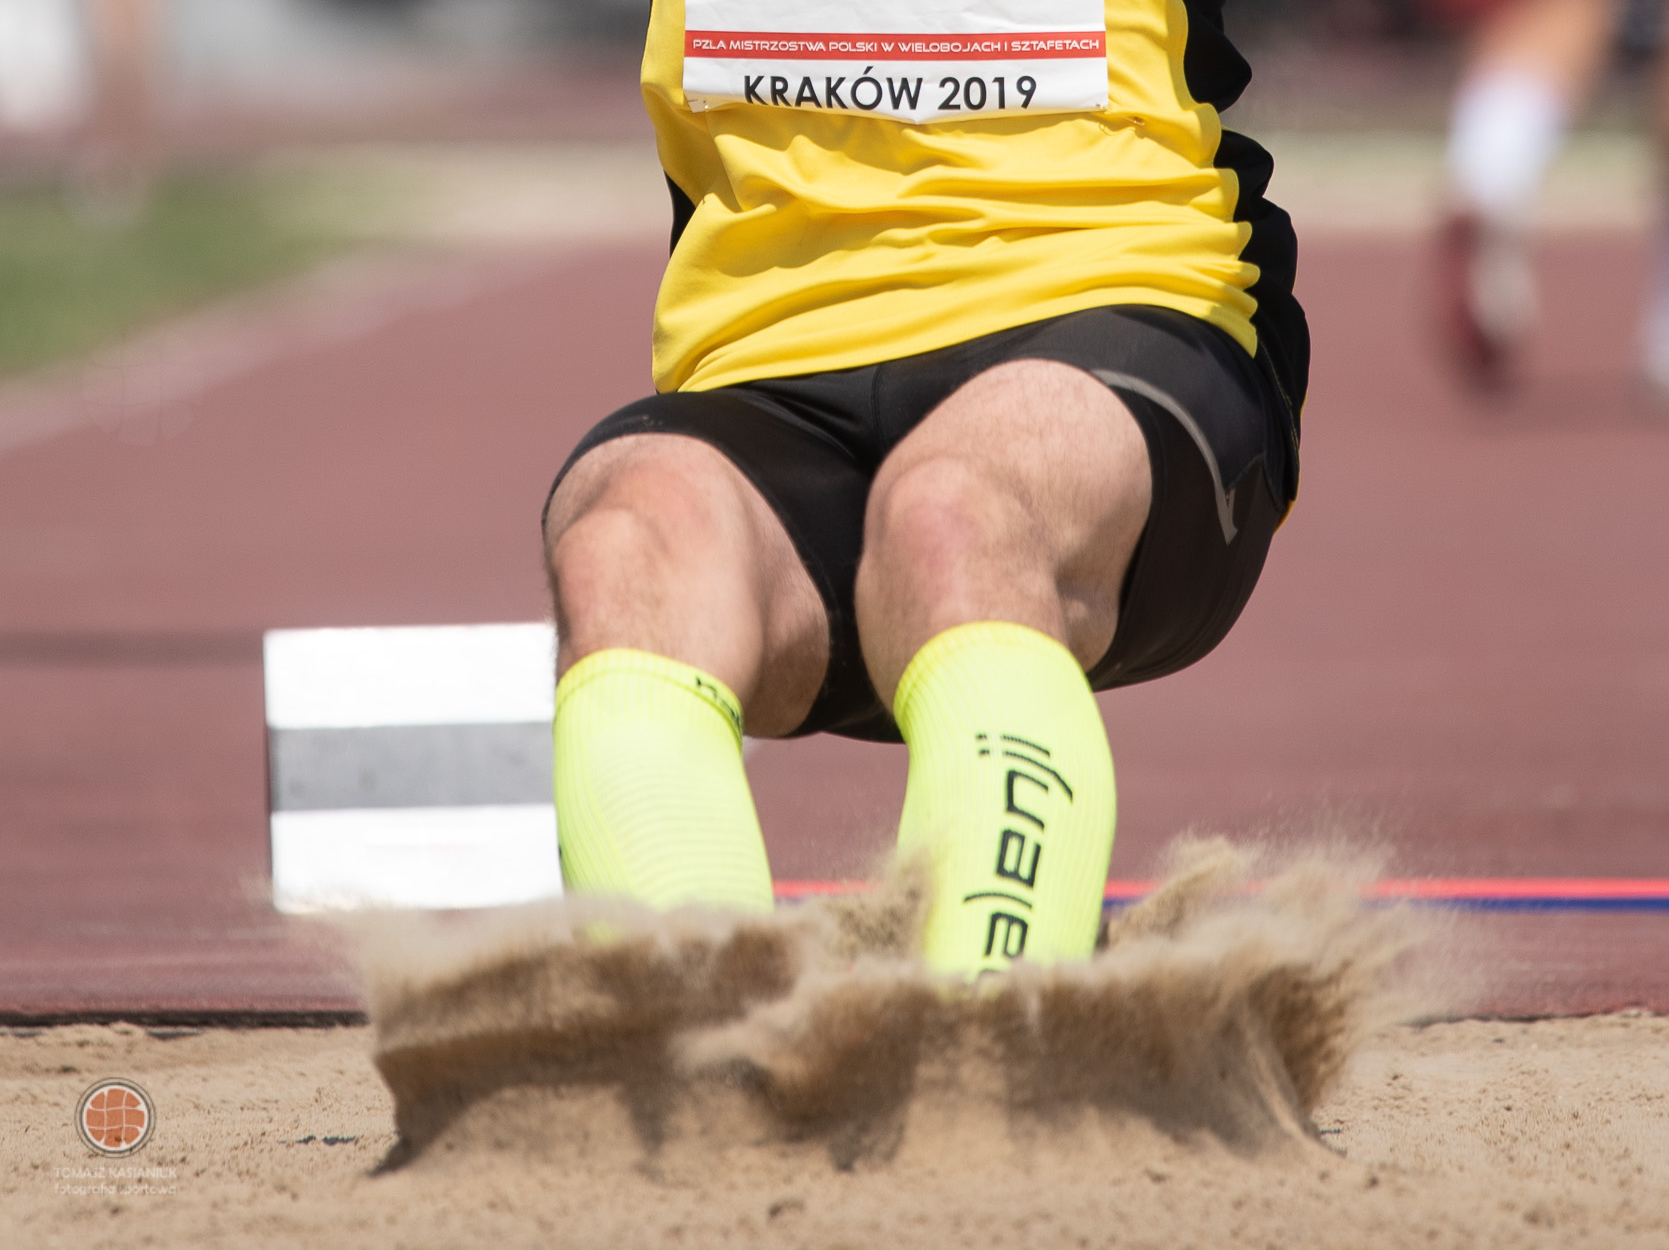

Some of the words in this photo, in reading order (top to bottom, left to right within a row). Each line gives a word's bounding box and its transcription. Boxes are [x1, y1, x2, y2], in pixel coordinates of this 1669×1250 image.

[692, 38, 726, 51] PZLA
[728, 40, 826, 52] MISTRZOSTWA
[828, 41, 878, 53] POLSKI
[881, 42, 895, 53] W
[897, 41, 1001, 54] WIELOBOJACH
[1004, 40, 1008, 52] I
[1010, 38, 1100, 52] SZTAFETACH
[743, 65, 924, 111] KRAKÓW
[937, 75, 1037, 111] 2019
[962, 732, 1074, 983] alenji
